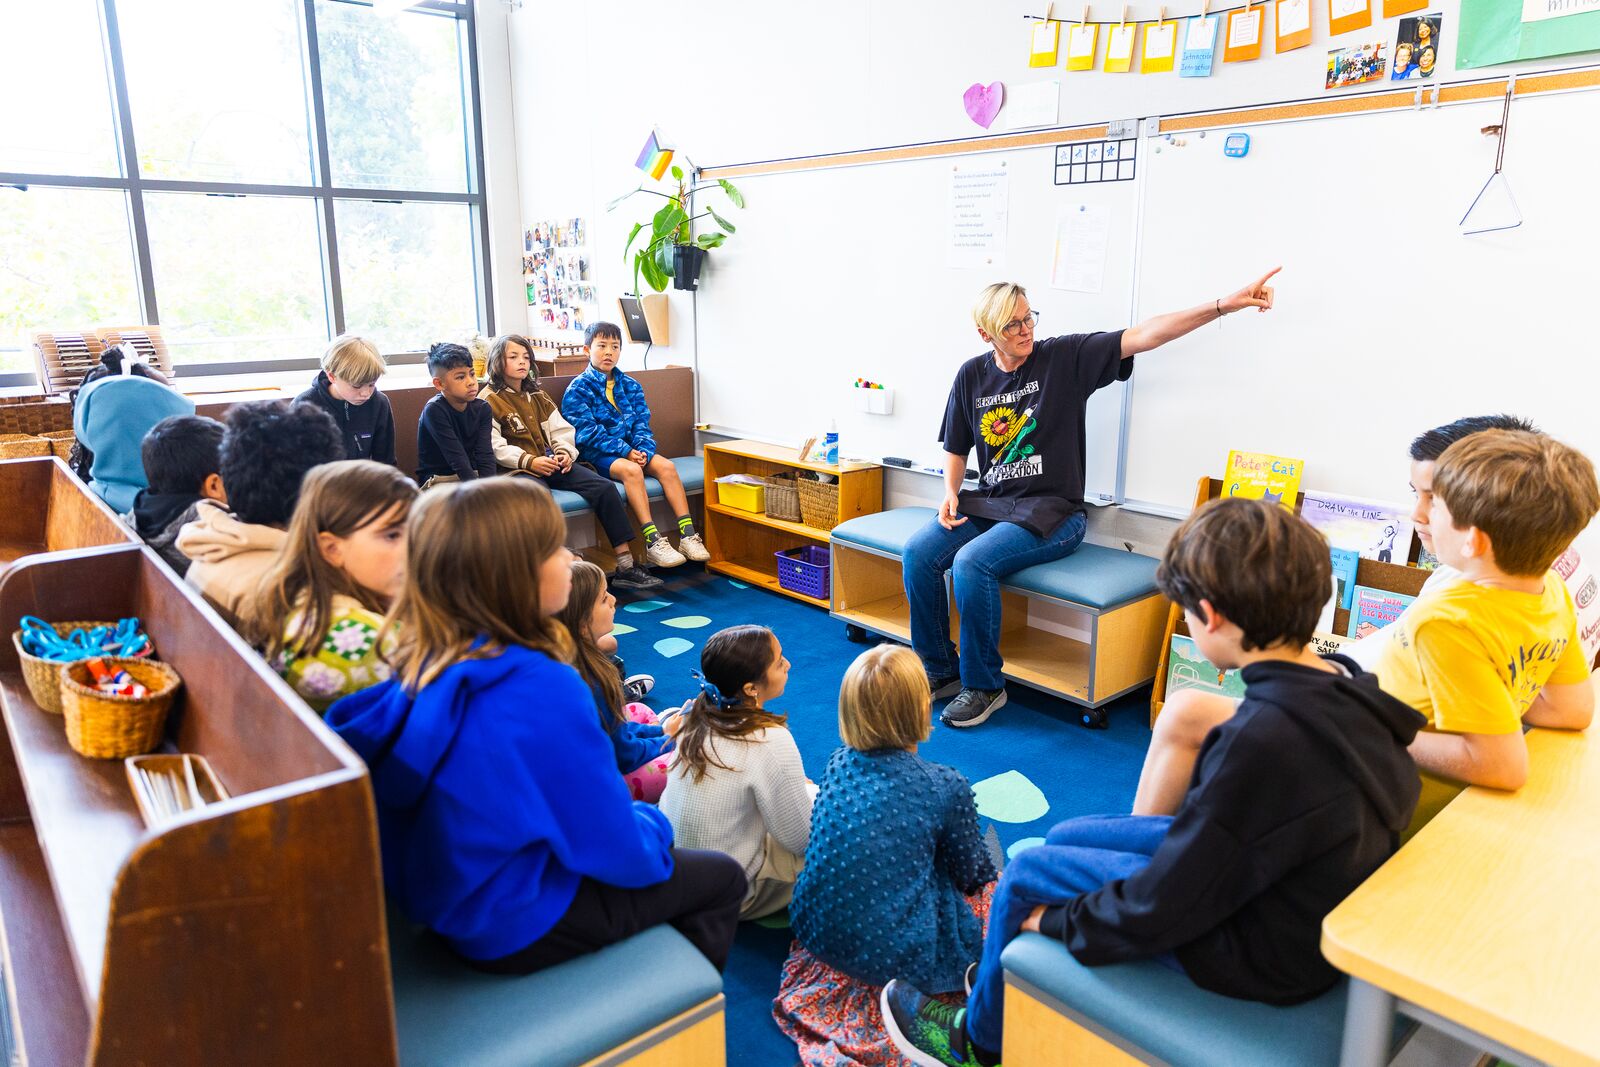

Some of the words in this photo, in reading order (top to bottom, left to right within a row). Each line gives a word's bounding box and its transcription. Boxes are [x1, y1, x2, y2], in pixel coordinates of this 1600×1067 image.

[1234, 454, 1261, 471] Pete
[1271, 460, 1295, 476] Cat
[1317, 501, 1347, 513] DRAW
[1348, 509, 1358, 517] the
[1361, 510, 1382, 520] LINE
[1358, 600, 1381, 609] GEORGE
[1362, 607, 1375, 617] BIG
[1377, 611, 1396, 622] RACE
[1322, 640, 1340, 649] AGA
